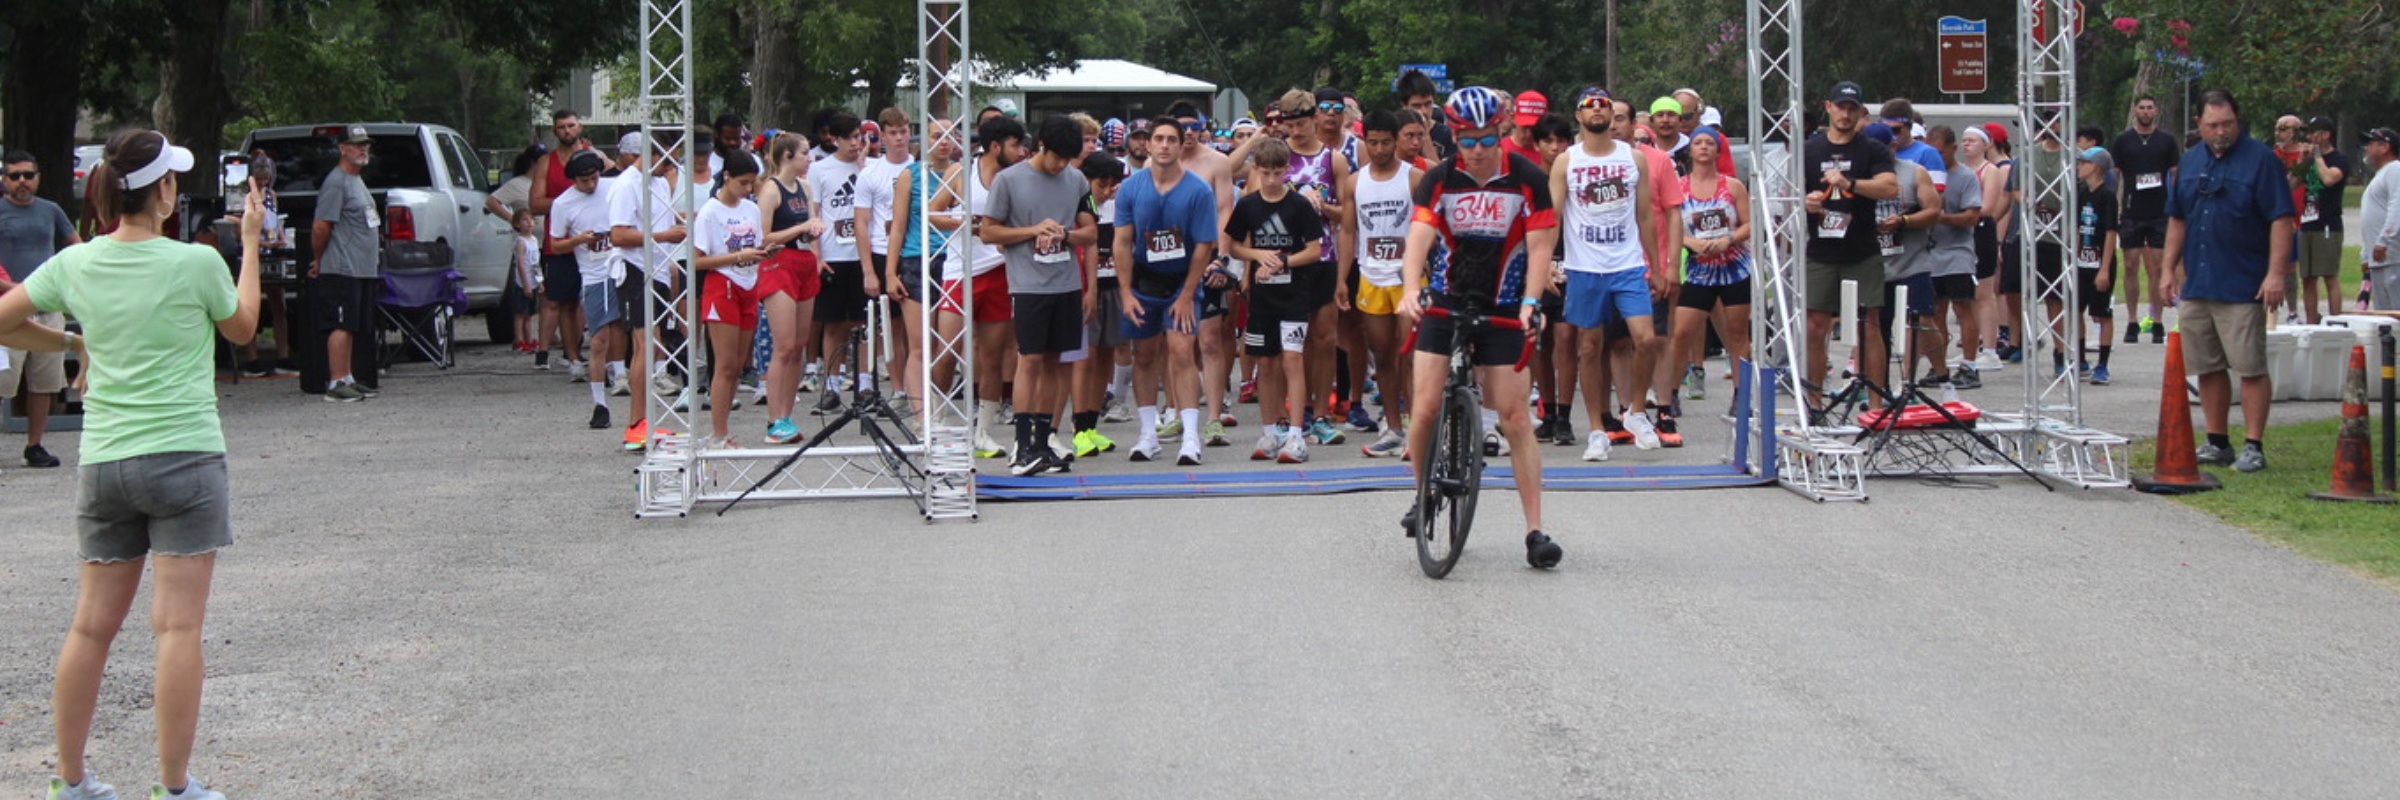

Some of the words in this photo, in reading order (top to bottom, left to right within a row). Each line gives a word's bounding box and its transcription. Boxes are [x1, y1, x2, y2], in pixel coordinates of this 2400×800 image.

[1573, 165, 1630, 184] TRUE
[1594, 184, 1619, 202] 708
[1700, 215, 1721, 230] 608
[1255, 232, 1293, 246] adidas
[1584, 224, 1627, 243] BLUE
[1152, 234, 1177, 251] 703
[1374, 243, 1398, 259] 577
